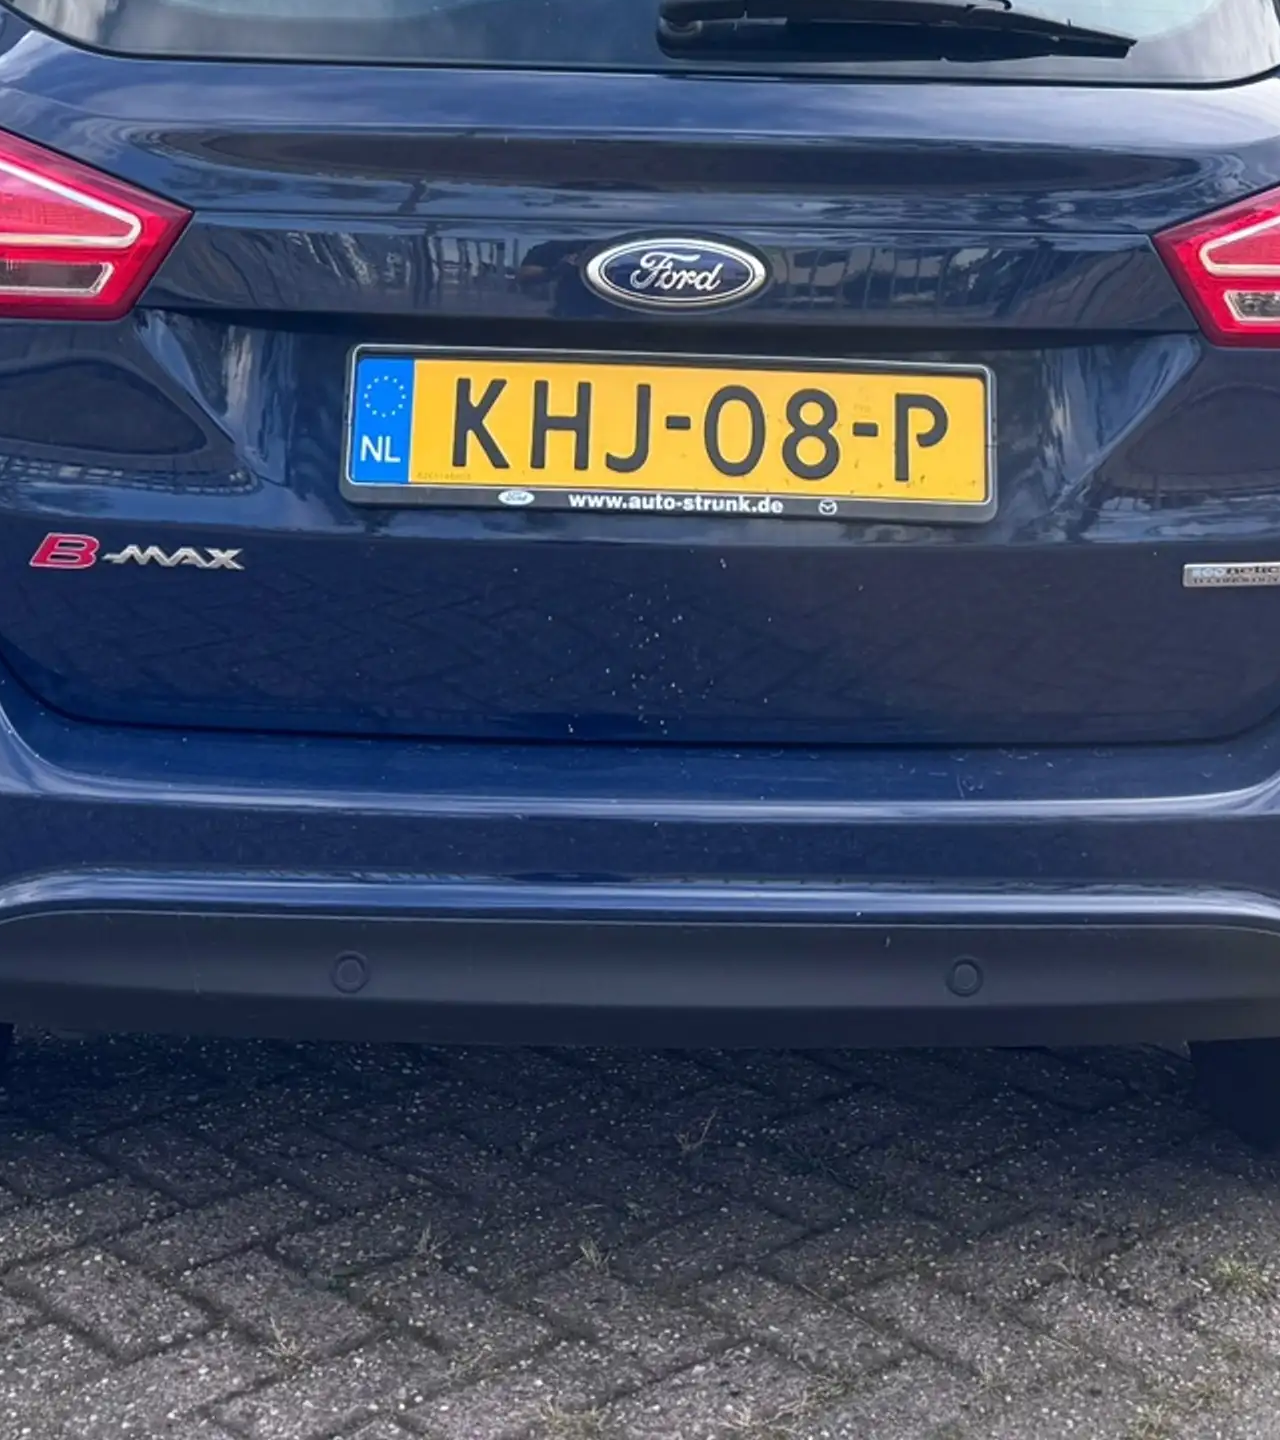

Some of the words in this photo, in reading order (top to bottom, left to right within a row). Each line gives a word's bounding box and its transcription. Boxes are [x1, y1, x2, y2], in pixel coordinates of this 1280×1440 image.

[630, 251, 724, 291] Ford
[450, 376, 950, 483] KHJ-08-P
[360, 435, 401, 464] NL
[568, 493, 784, 514] www.auto-strunk.de
